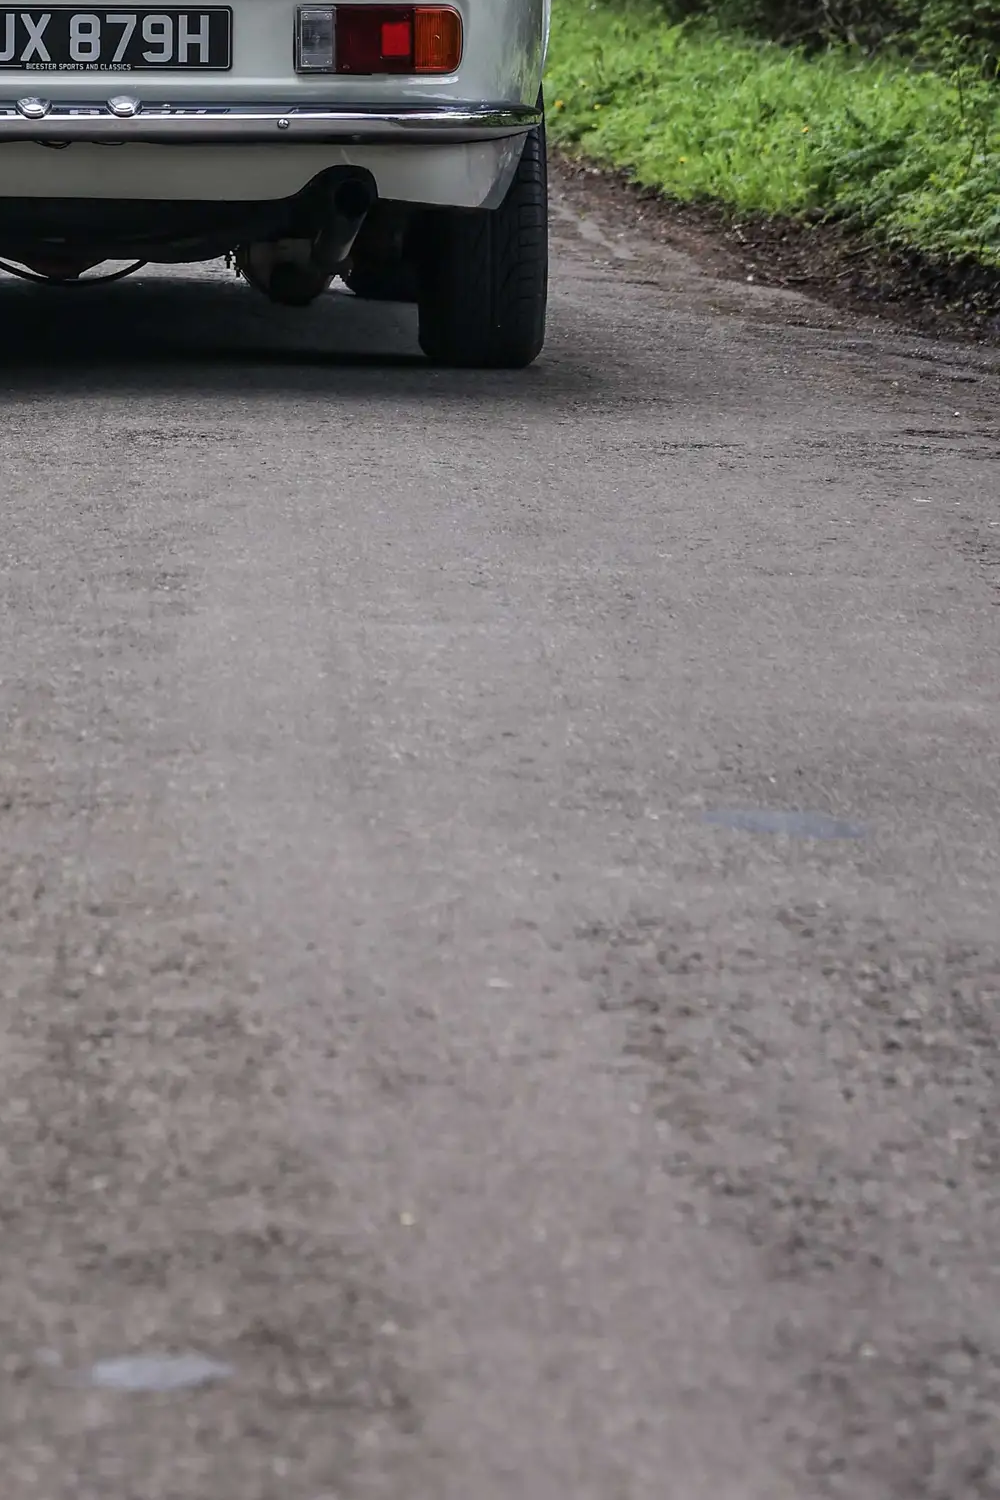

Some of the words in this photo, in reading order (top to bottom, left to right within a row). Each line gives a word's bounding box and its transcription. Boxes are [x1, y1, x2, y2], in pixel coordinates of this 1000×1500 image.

[69, 14, 210, 63] 879H
[85, 63, 99, 71] AND
[99, 63, 132, 71] CLASSICS
